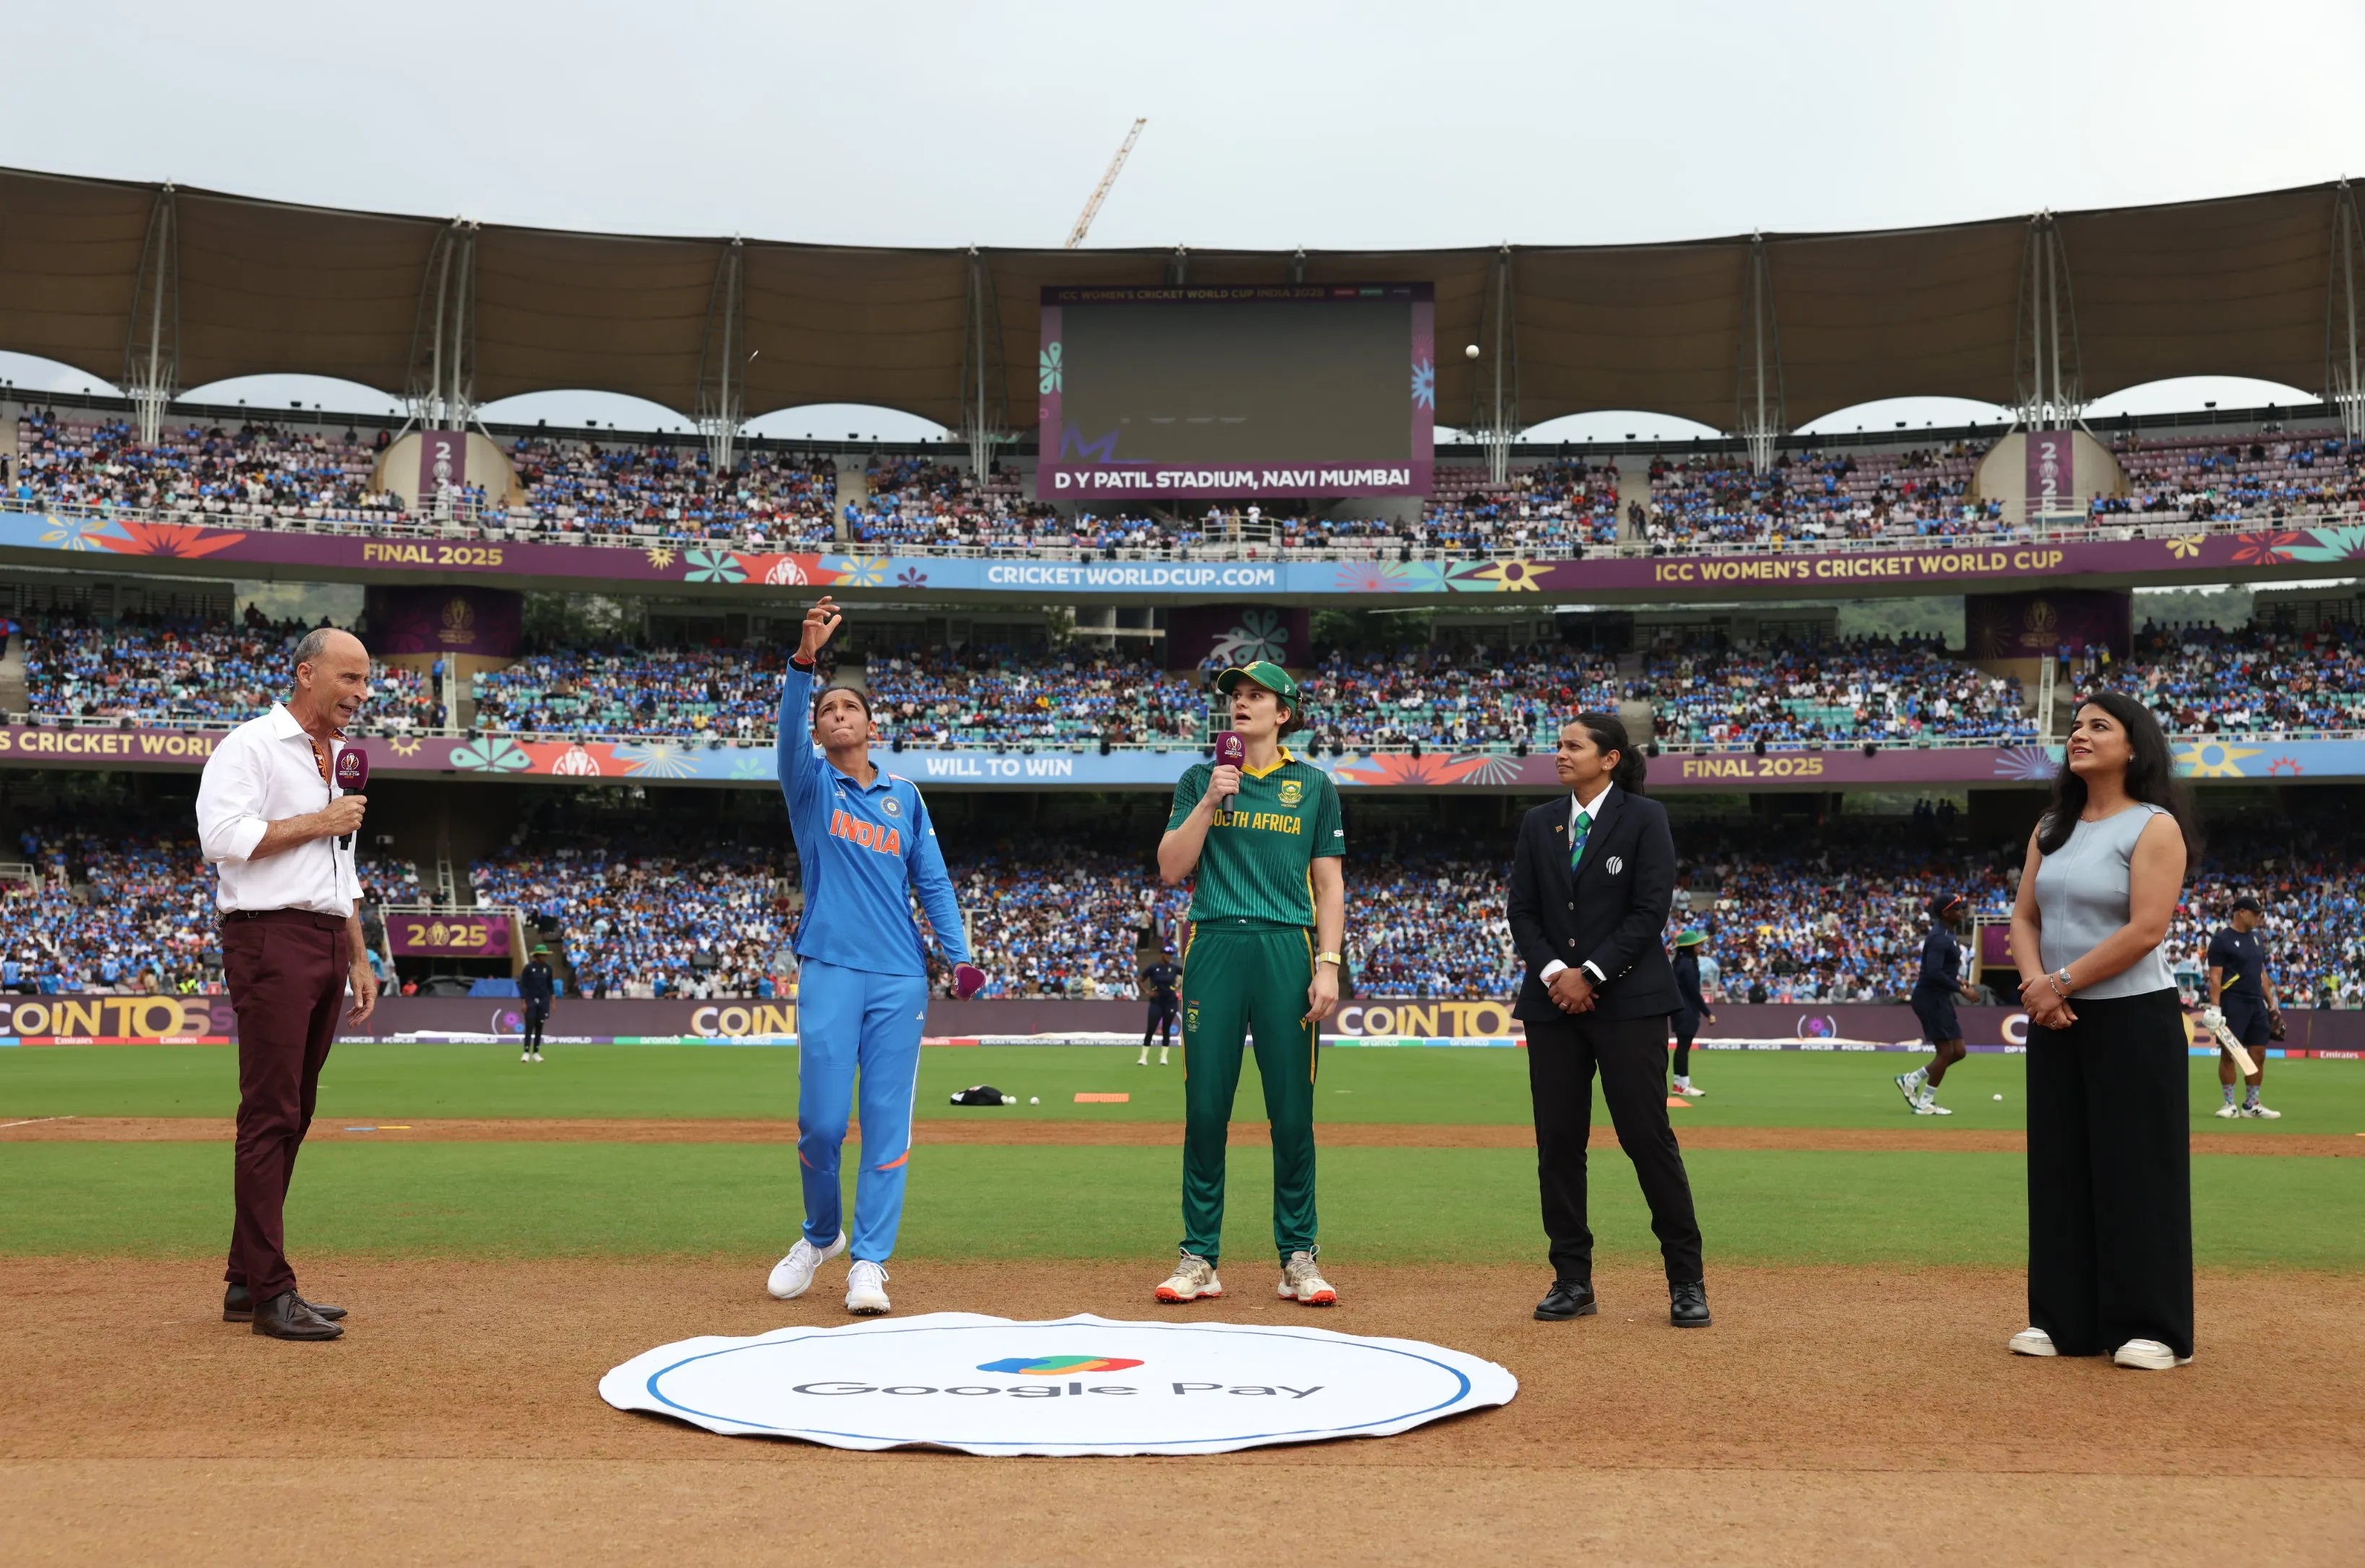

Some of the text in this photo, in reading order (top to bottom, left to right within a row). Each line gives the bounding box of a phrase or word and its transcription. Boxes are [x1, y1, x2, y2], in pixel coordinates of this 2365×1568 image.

[1059, 291, 1077, 300] ICC
[1136, 289, 1183, 299] CRICKET
[1186, 289, 1229, 299] WORLD
[1231, 289, 1254, 298] CUP
[1257, 289, 1291, 297] INDIA
[1055, 469, 1410, 490] D Y PATIL STADIUM, NAVI MUMBAI
[363, 543, 503, 566] FINAL 2025
[988, 565, 1275, 586] CRICKETWORLDCUP.COM
[1655, 550, 2063, 582] ICC WOMEN'S CRICKET WORLD CUP
[19, 731, 134, 754] CRICKET
[139, 735, 216, 757] WORL
[926, 758, 1073, 777] WILL TO WIN
[1683, 757, 1824, 778] FINAL 2025
[829, 809, 900, 857] INDIA
[1252, 811, 1302, 835] AFRICA
[691, 1005, 795, 1037] COIN
[1337, 1004, 1438, 1037] COIN
[54, 1036, 94, 1045] Emirates
[160, 1036, 198, 1045] Emirates
[640, 1035, 681, 1045] aramco
[731, 1036, 772, 1045] aramco
[1359, 1038, 1399, 1047] aramco
[1450, 1038, 1489, 1047] aramco
[2320, 1050, 2359, 1059] Emirates
[792, 1382, 1325, 1399] Google Pay
